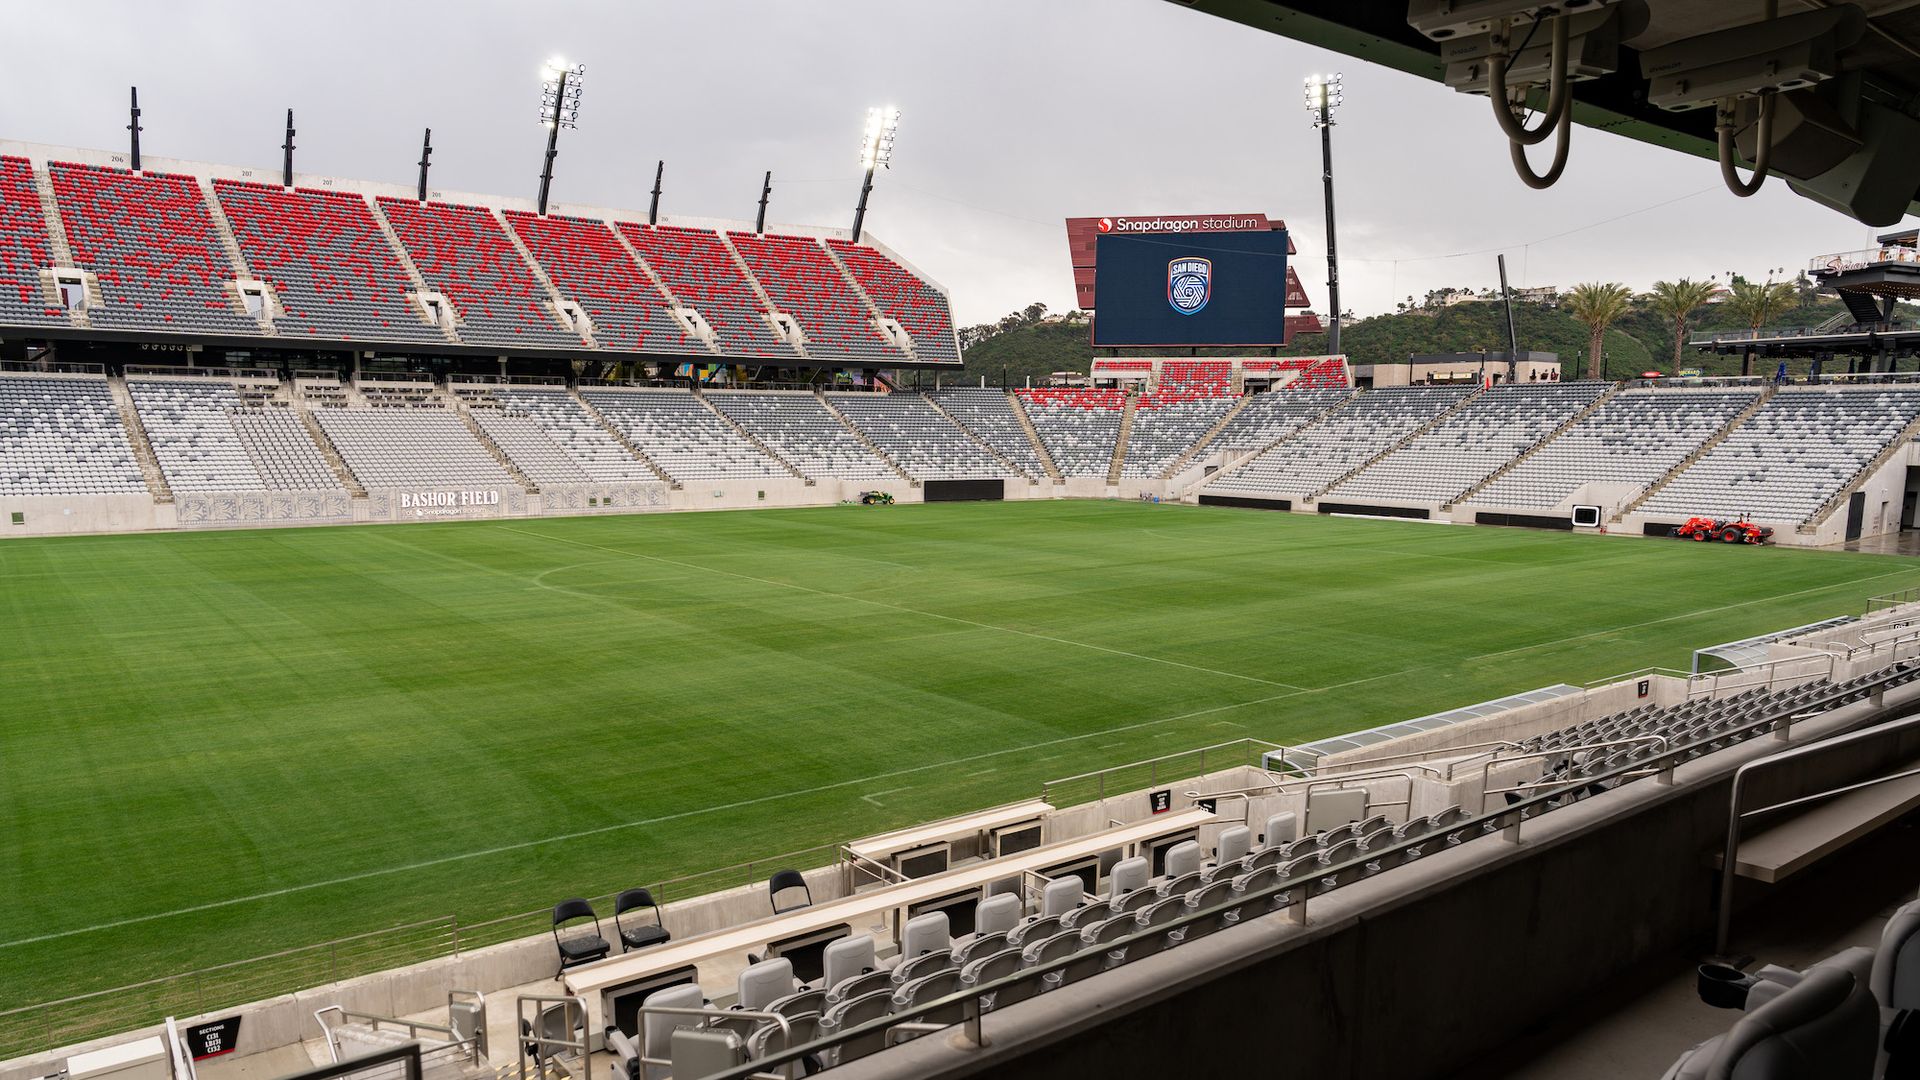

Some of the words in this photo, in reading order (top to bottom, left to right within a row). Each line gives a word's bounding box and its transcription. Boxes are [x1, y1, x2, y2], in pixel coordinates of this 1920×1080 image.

[111, 155, 124, 163] 206
[1117, 217, 1198, 233] Snapdragon
[1203, 216, 1257, 229] stadium
[1173, 263, 1187, 274] SAN
[1188, 263, 1207, 273] DIEGO
[401, 492, 456, 508] BASHOR
[461, 490, 499, 505] FIELD
[424, 508, 462, 516] Snapdragon
[199, 1024, 224, 1035] SECTIONS
